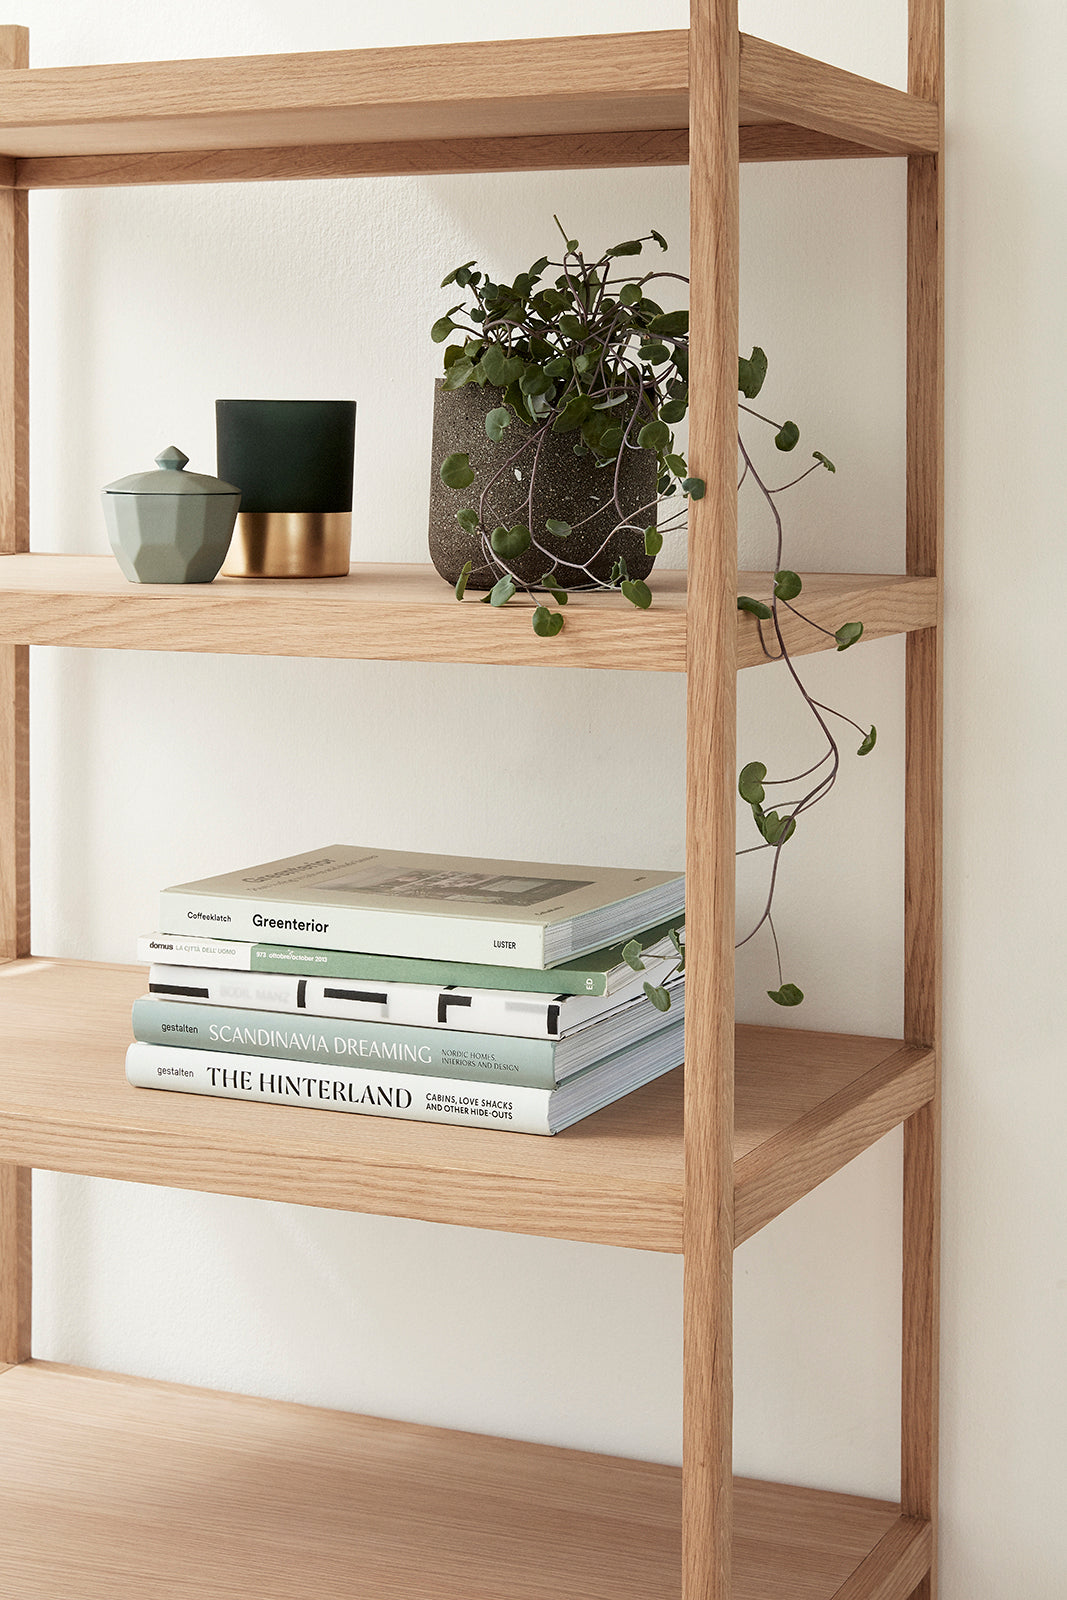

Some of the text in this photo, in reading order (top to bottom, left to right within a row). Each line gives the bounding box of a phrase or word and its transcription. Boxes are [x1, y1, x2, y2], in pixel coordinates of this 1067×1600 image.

[187, 911, 517, 950] Coffeeklatch Greenterior LUSTER
[149, 941, 174, 951] domus
[217, 947, 236, 956] UOMO
[585, 978, 594, 990] ED
[161, 1023, 432, 1064] gestalten SCANDINAVIA DREAMING
[441, 1049, 469, 1059] NORDIC
[441, 1057, 520, 1072] INTERIORS AND DESIGN
[157, 1066, 412, 1109] gestalten THE HINTERLAND
[425, 1093, 513, 1110] CABINS, LOVE SHACKS
[426, 1103, 513, 1120] AND OTHER HIDE-OUTS
